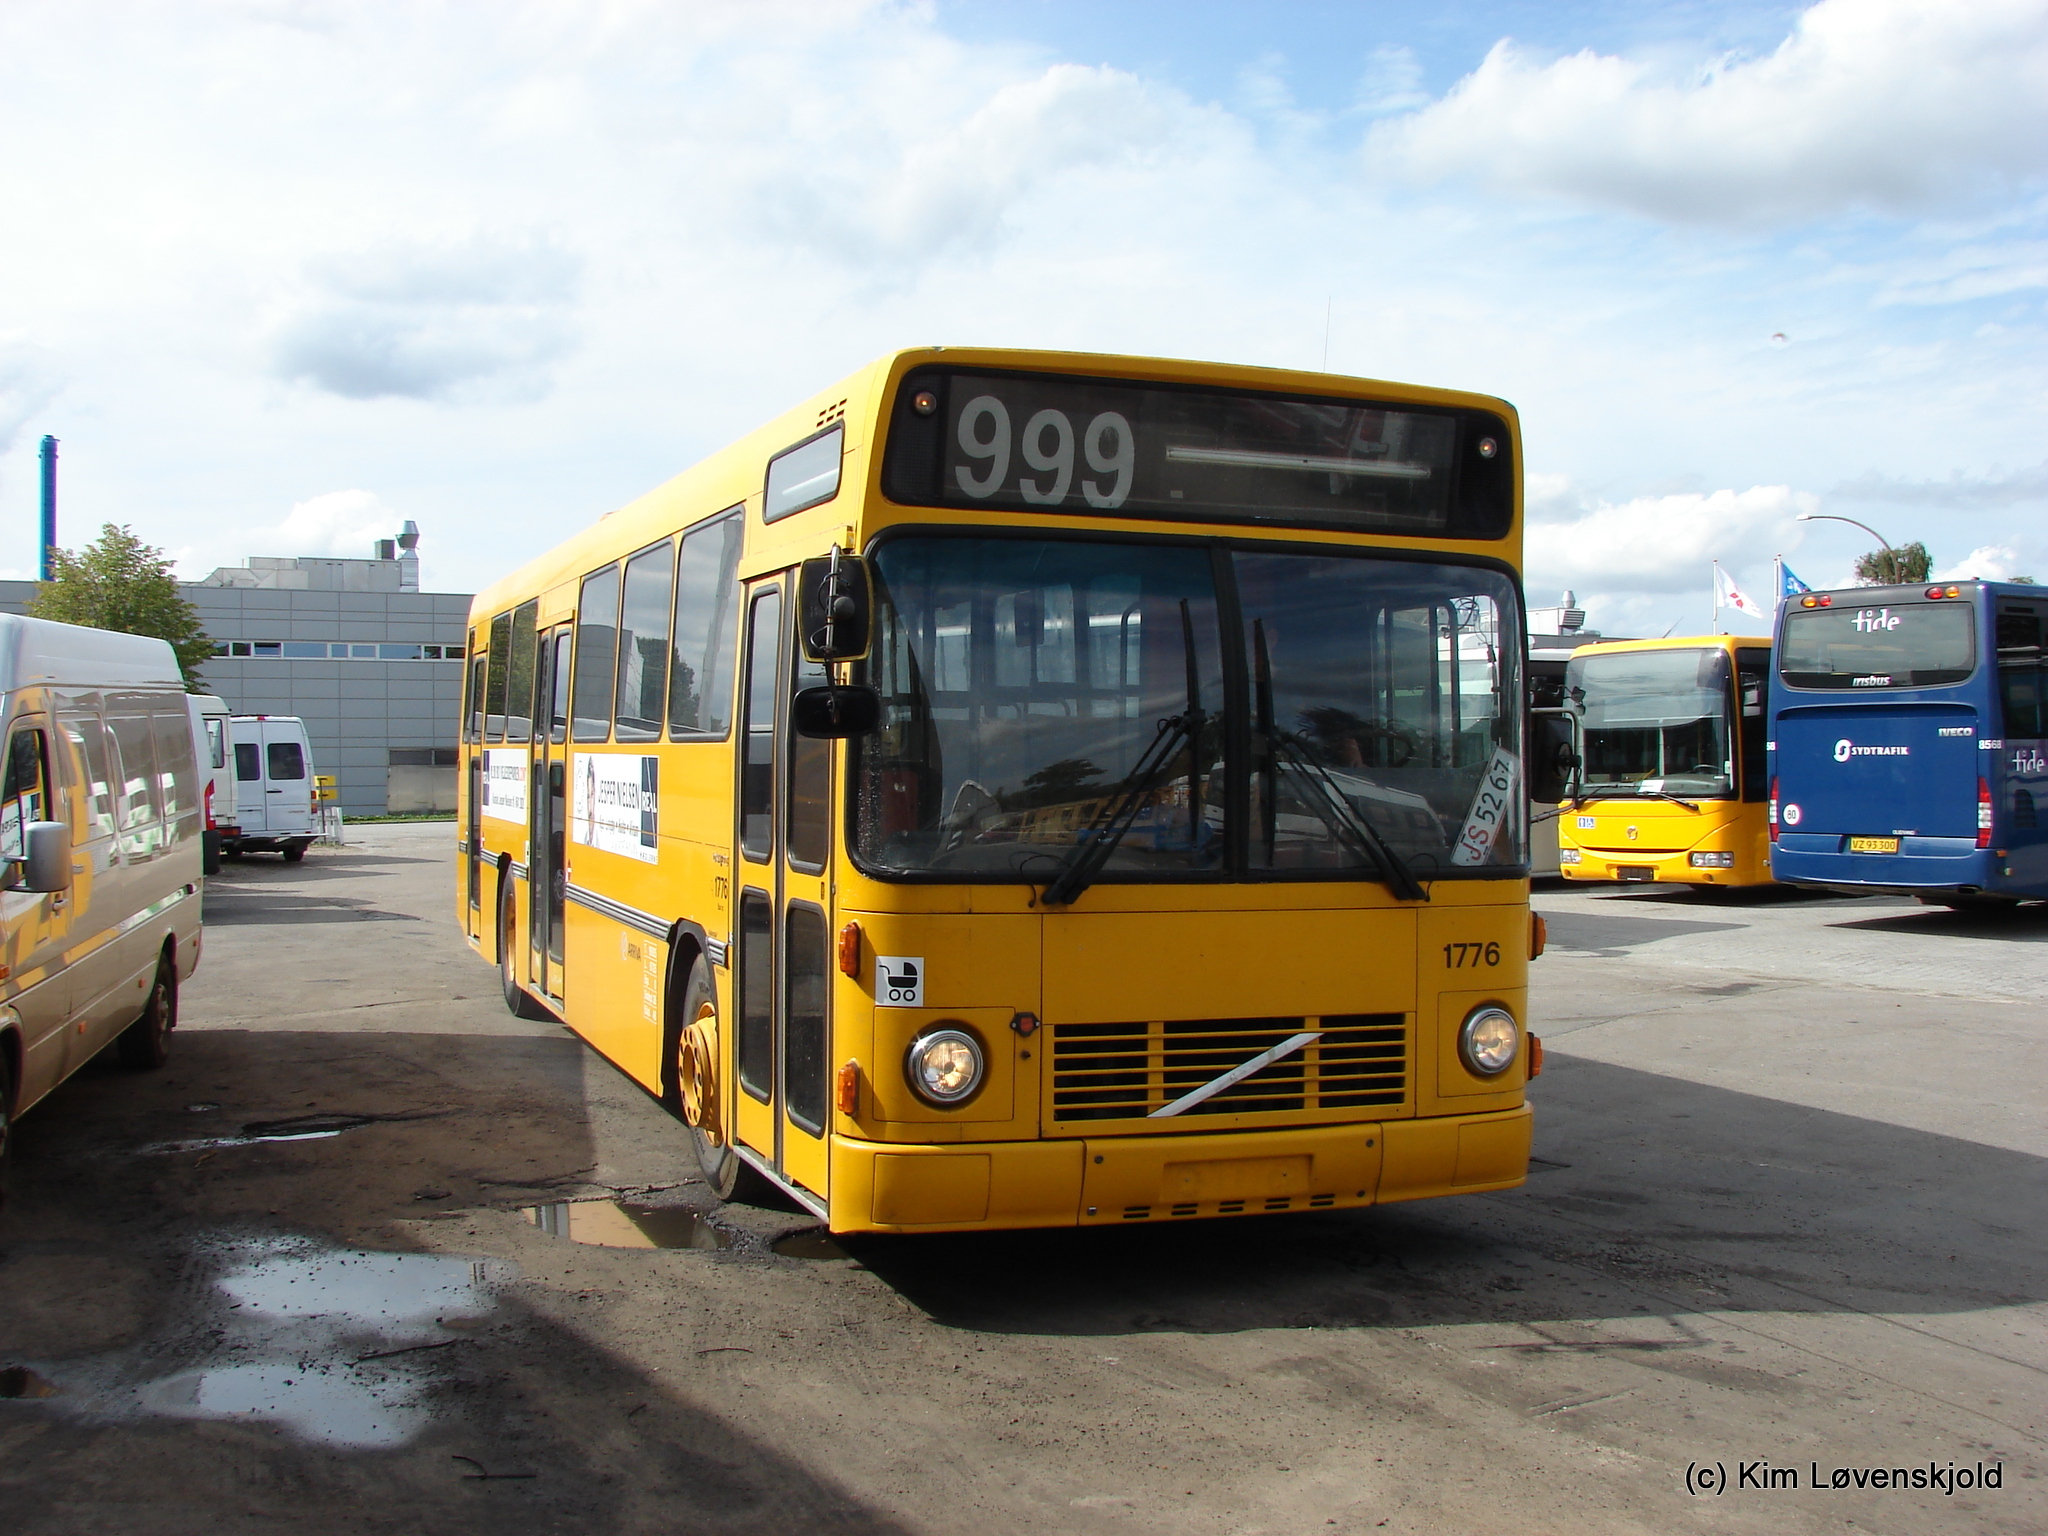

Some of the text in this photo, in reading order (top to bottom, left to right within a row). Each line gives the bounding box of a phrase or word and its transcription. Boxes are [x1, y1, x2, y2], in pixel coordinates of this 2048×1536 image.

[954, 395, 1138, 509] 999
[1851, 609, 1900, 633] tide
[1938, 727, 1973, 737] IVECO
[1851, 746, 1909, 756] SYDTRAFIK
[2012, 749, 2045, 773] tide
[598, 780, 640, 810] JESPER NIELSEN
[1787, 809, 1797, 820] 80
[1462, 825, 1490, 861] JS
[1853, 840, 1896, 850] VZ 93 300
[715, 876, 728, 899] 1776
[1443, 941, 1501, 969] 1776
